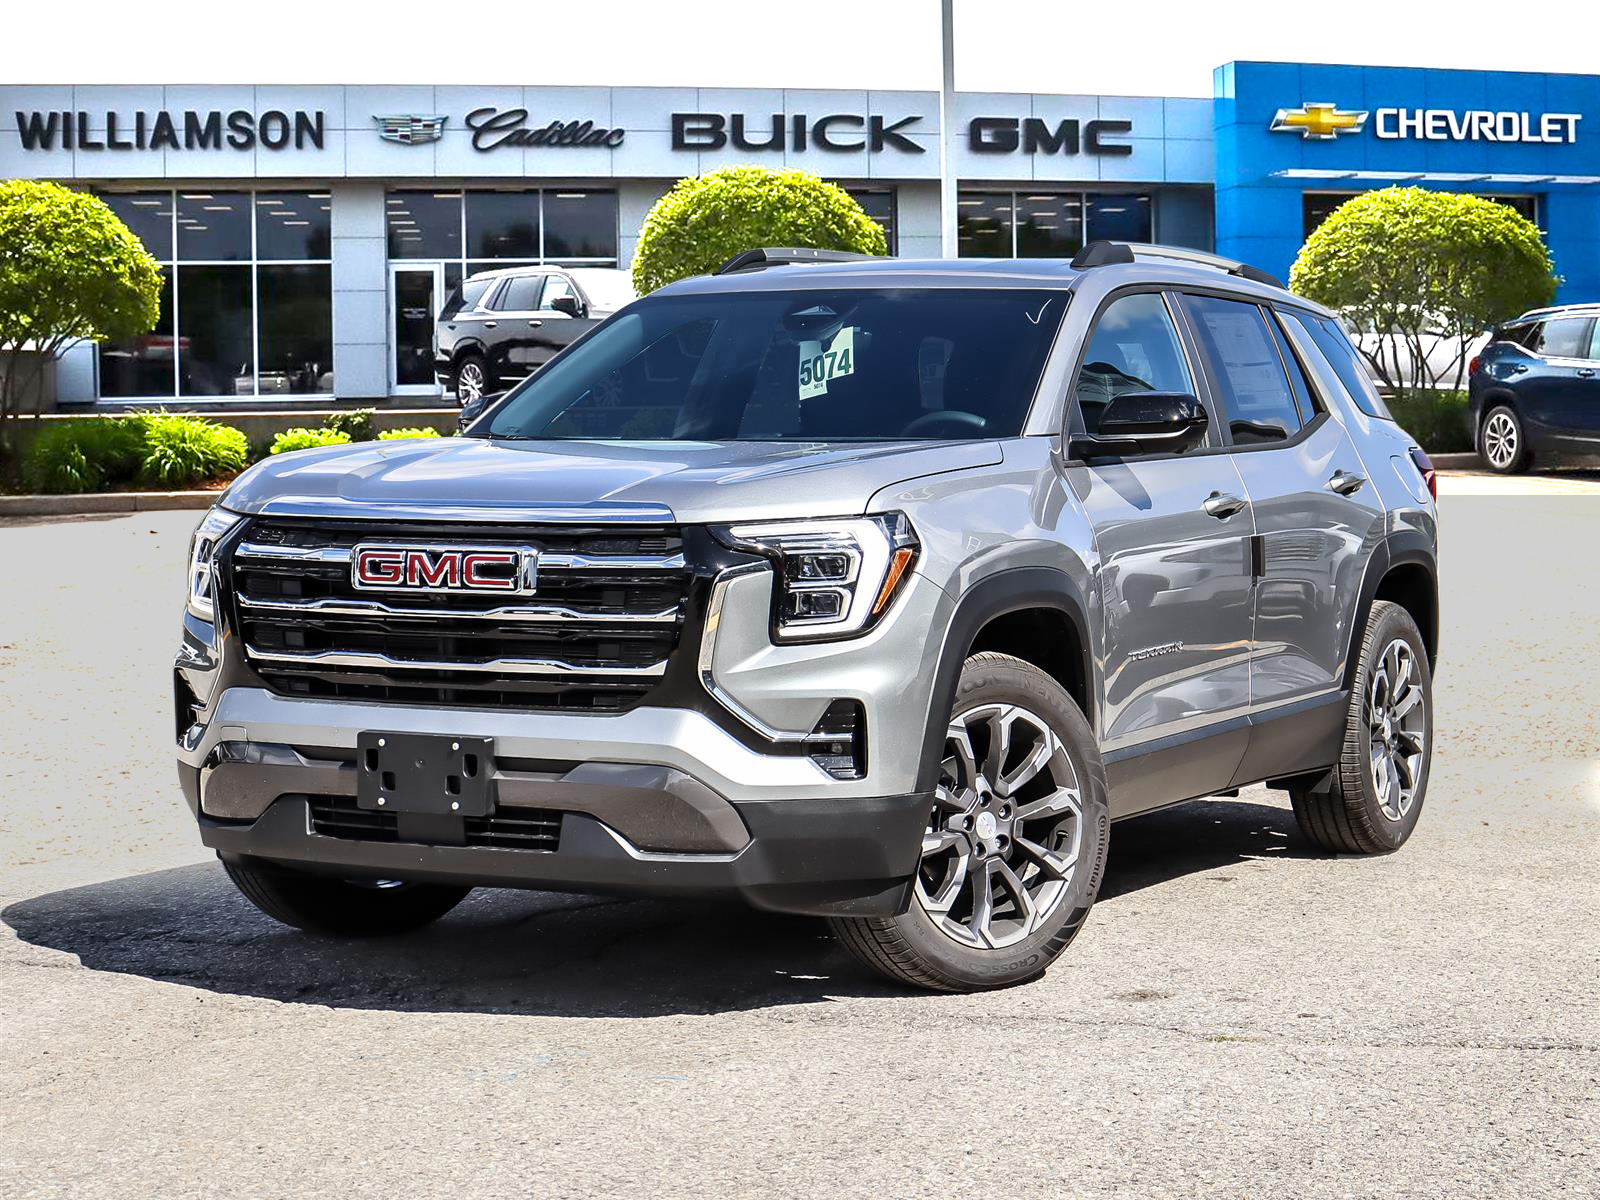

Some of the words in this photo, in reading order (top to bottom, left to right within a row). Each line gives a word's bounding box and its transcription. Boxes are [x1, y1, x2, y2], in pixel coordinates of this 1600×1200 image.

[16, 111, 324, 151] WILLIAMSON
[465, 107, 624, 152] Cadillac
[671, 113, 926, 153] BUICK
[969, 117, 1133, 155] GMC
[1376, 108, 1581, 143] CHEVROLET
[800, 348, 851, 386] 5074
[359, 552, 515, 588] GMC
[1089, 815, 1106, 889] Continental
